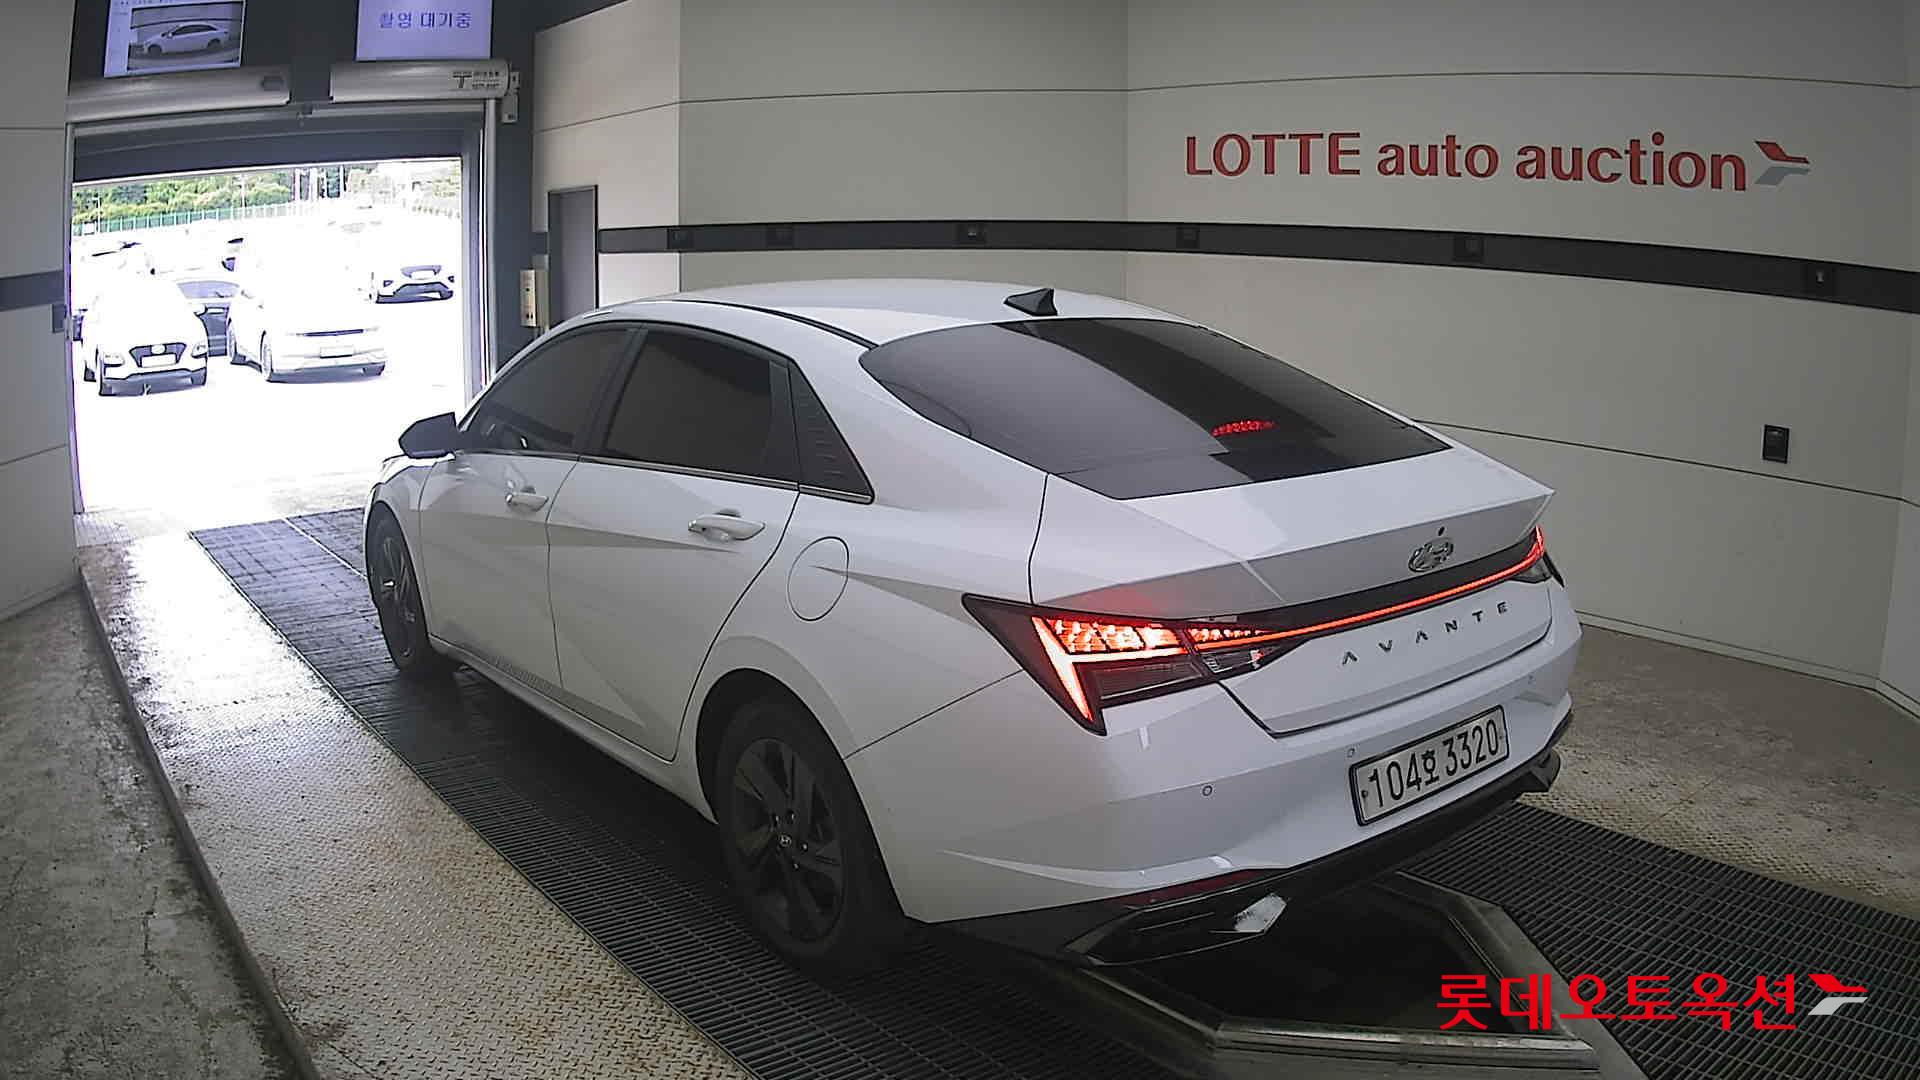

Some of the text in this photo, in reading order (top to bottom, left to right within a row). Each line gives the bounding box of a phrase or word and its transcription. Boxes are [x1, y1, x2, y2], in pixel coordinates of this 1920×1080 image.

[421, 12, 472, 28] 대기중
[1186, 131, 1747, 191] LOTTE auto auction
[1342, 601, 1508, 666] AVANTE
[1368, 719, 1499, 808] 104호 3320
